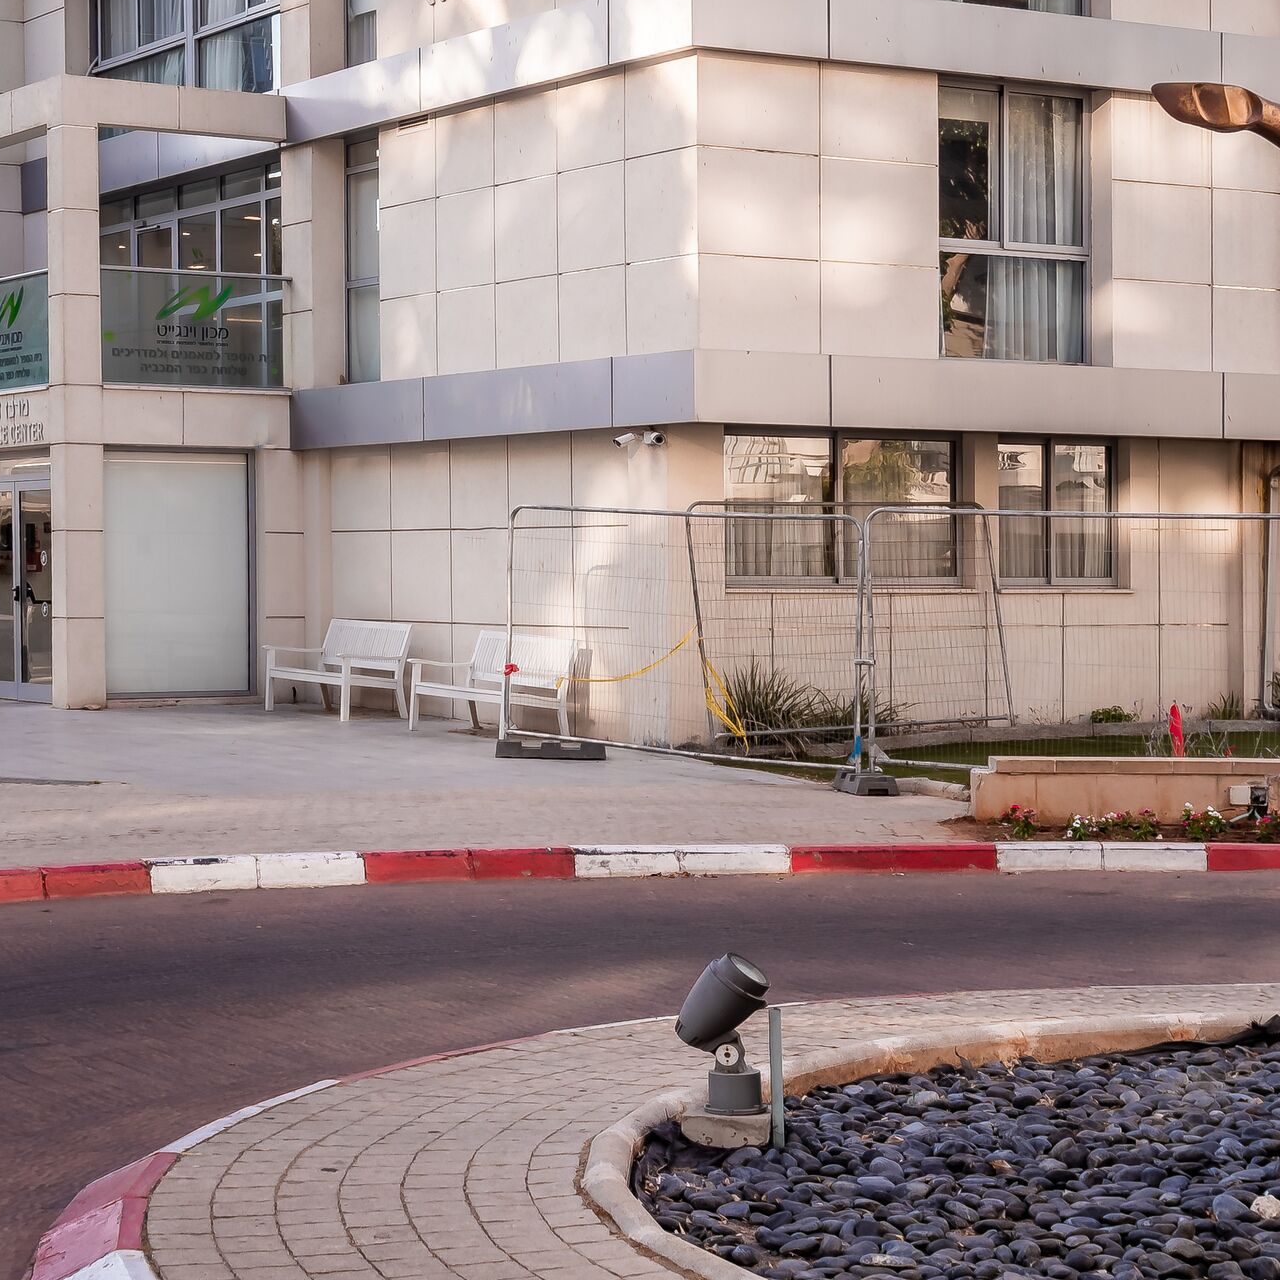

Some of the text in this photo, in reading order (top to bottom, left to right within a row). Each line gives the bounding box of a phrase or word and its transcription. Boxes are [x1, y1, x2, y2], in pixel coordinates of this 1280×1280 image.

[157, 323, 229, 341] מכון וינגייט
[111, 346, 168, 359] ולמדריכים
[171, 348, 221, 360] למאמנים
[223, 352, 255, 362] הספר
[140, 363, 248, 376] שלוחת כפר המכביה
[5, 399, 30, 419] מרכז
[10, 422, 45, 445] CENTER
